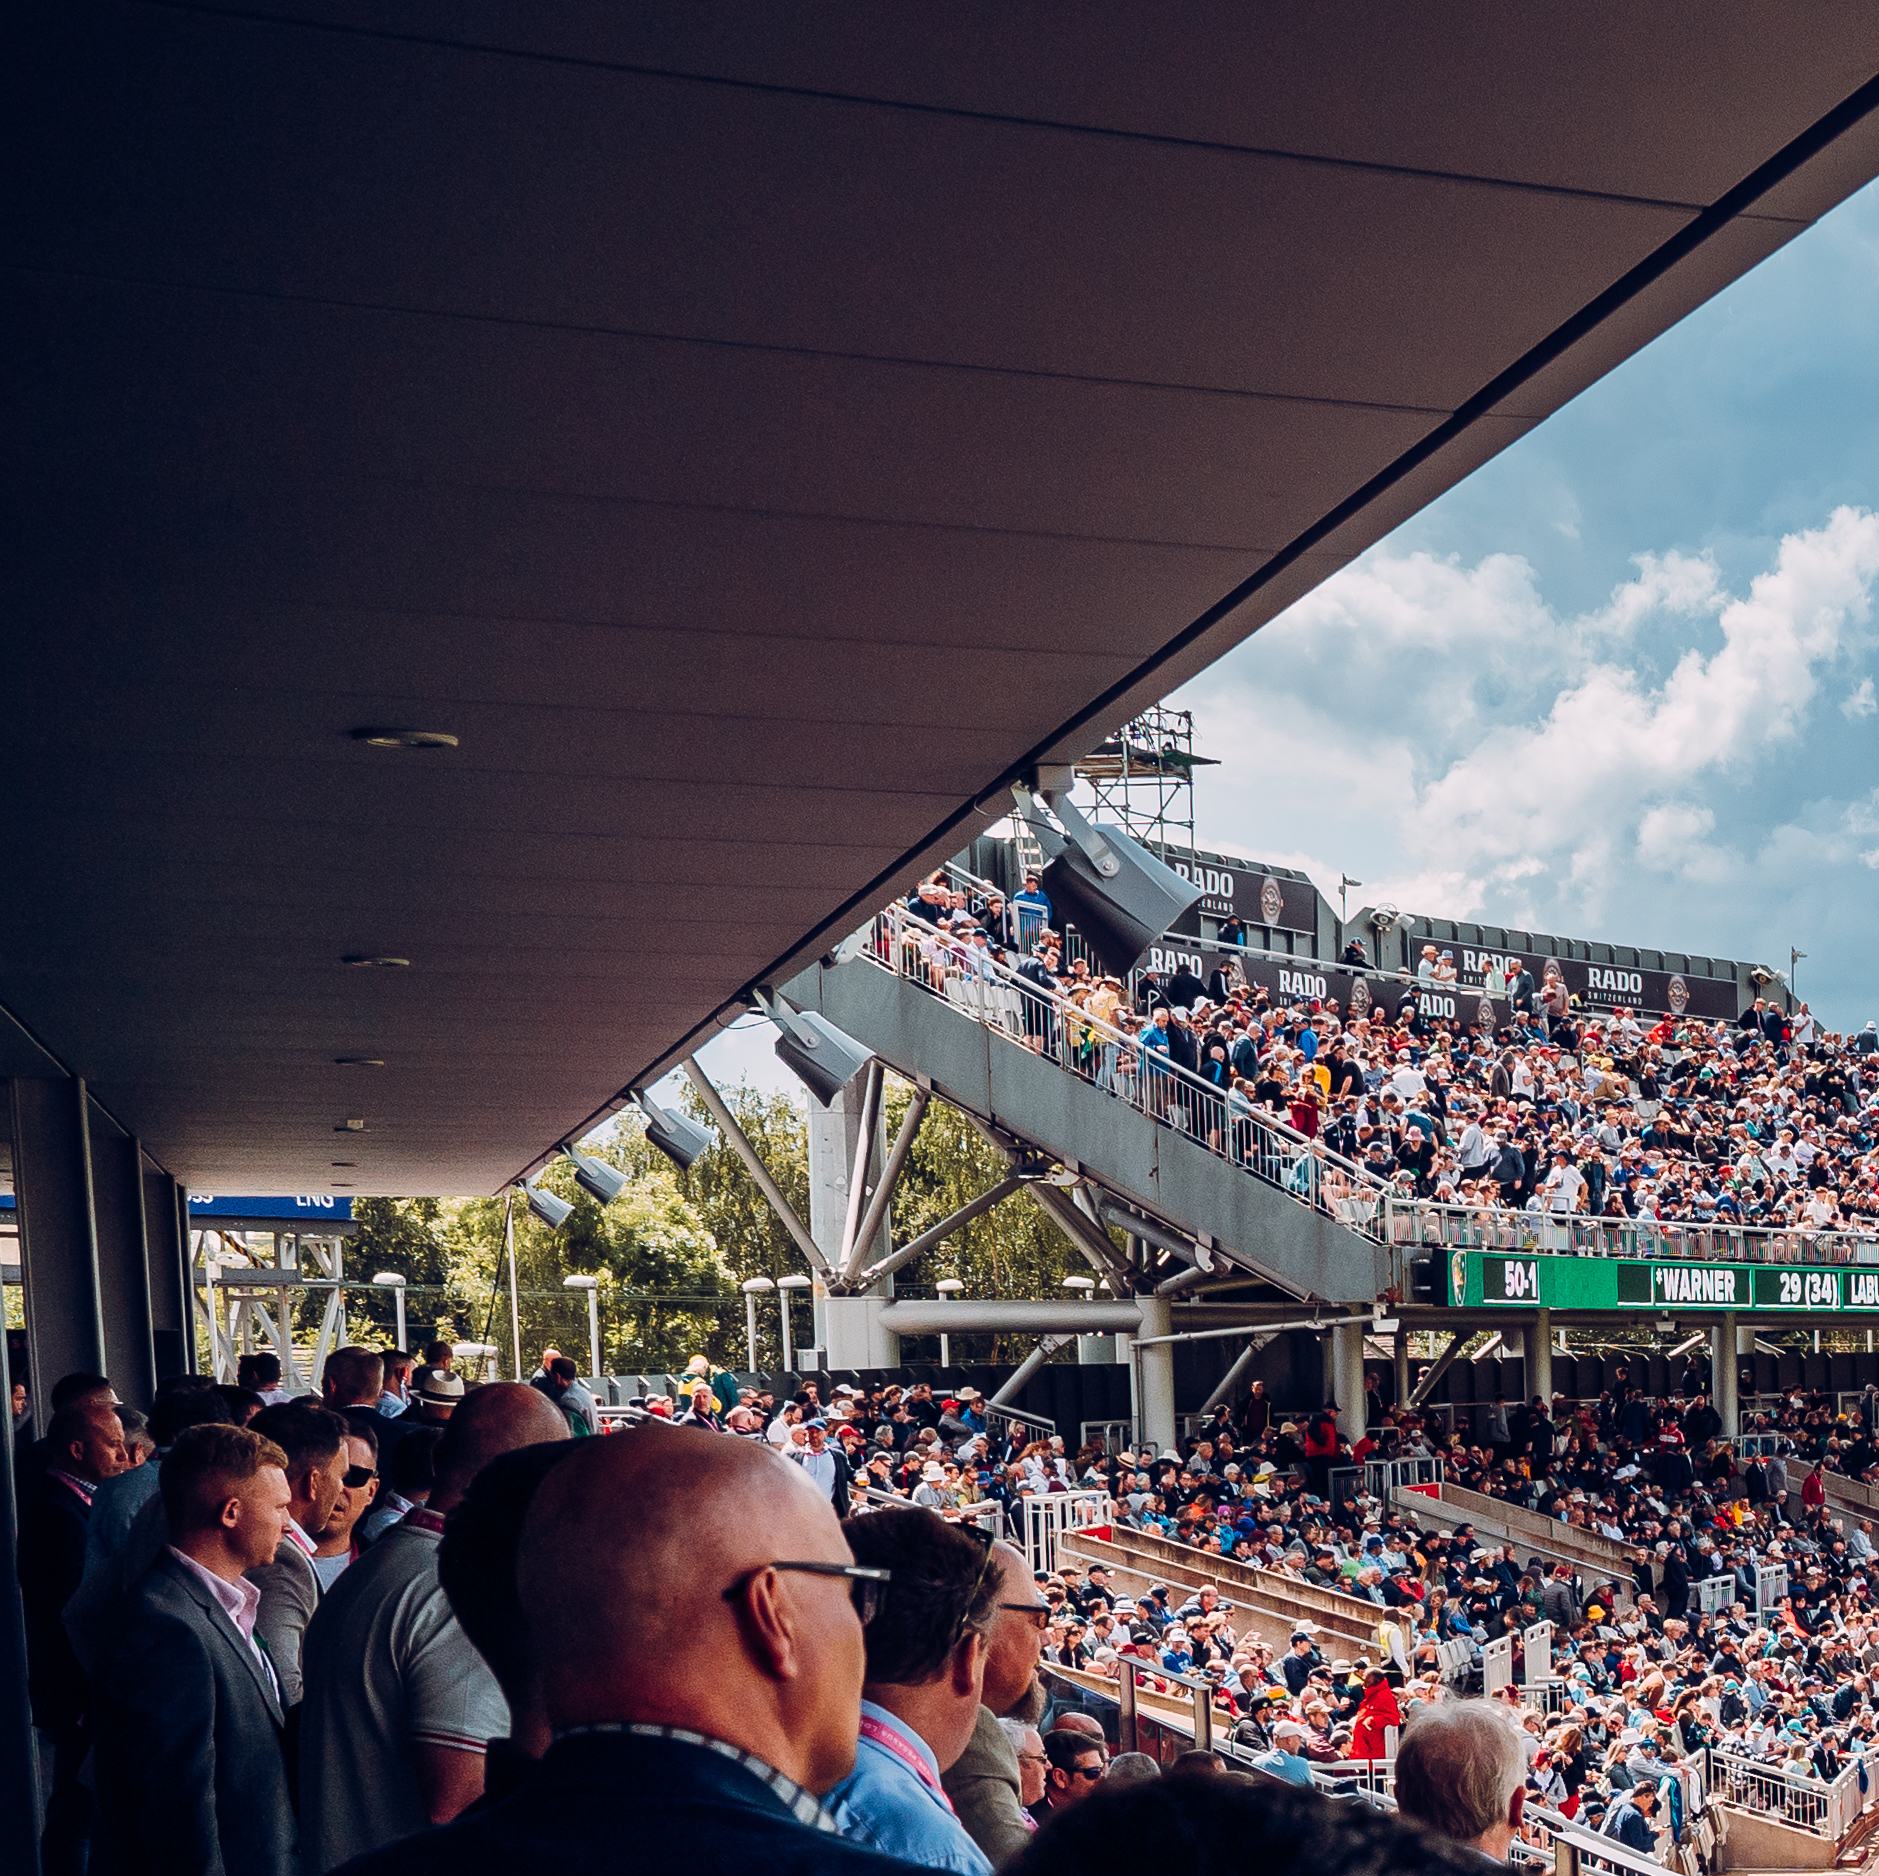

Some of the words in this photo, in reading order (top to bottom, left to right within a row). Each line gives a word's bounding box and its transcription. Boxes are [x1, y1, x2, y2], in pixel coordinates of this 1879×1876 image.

[1278, 969, 1327, 999] RADO
[1588, 967, 1643, 994] RADO
[1504, 1260, 1537, 1297] 50-1
[1780, 1272, 1802, 1304] 29
[1805, 1273, 1838, 1312] (34)
